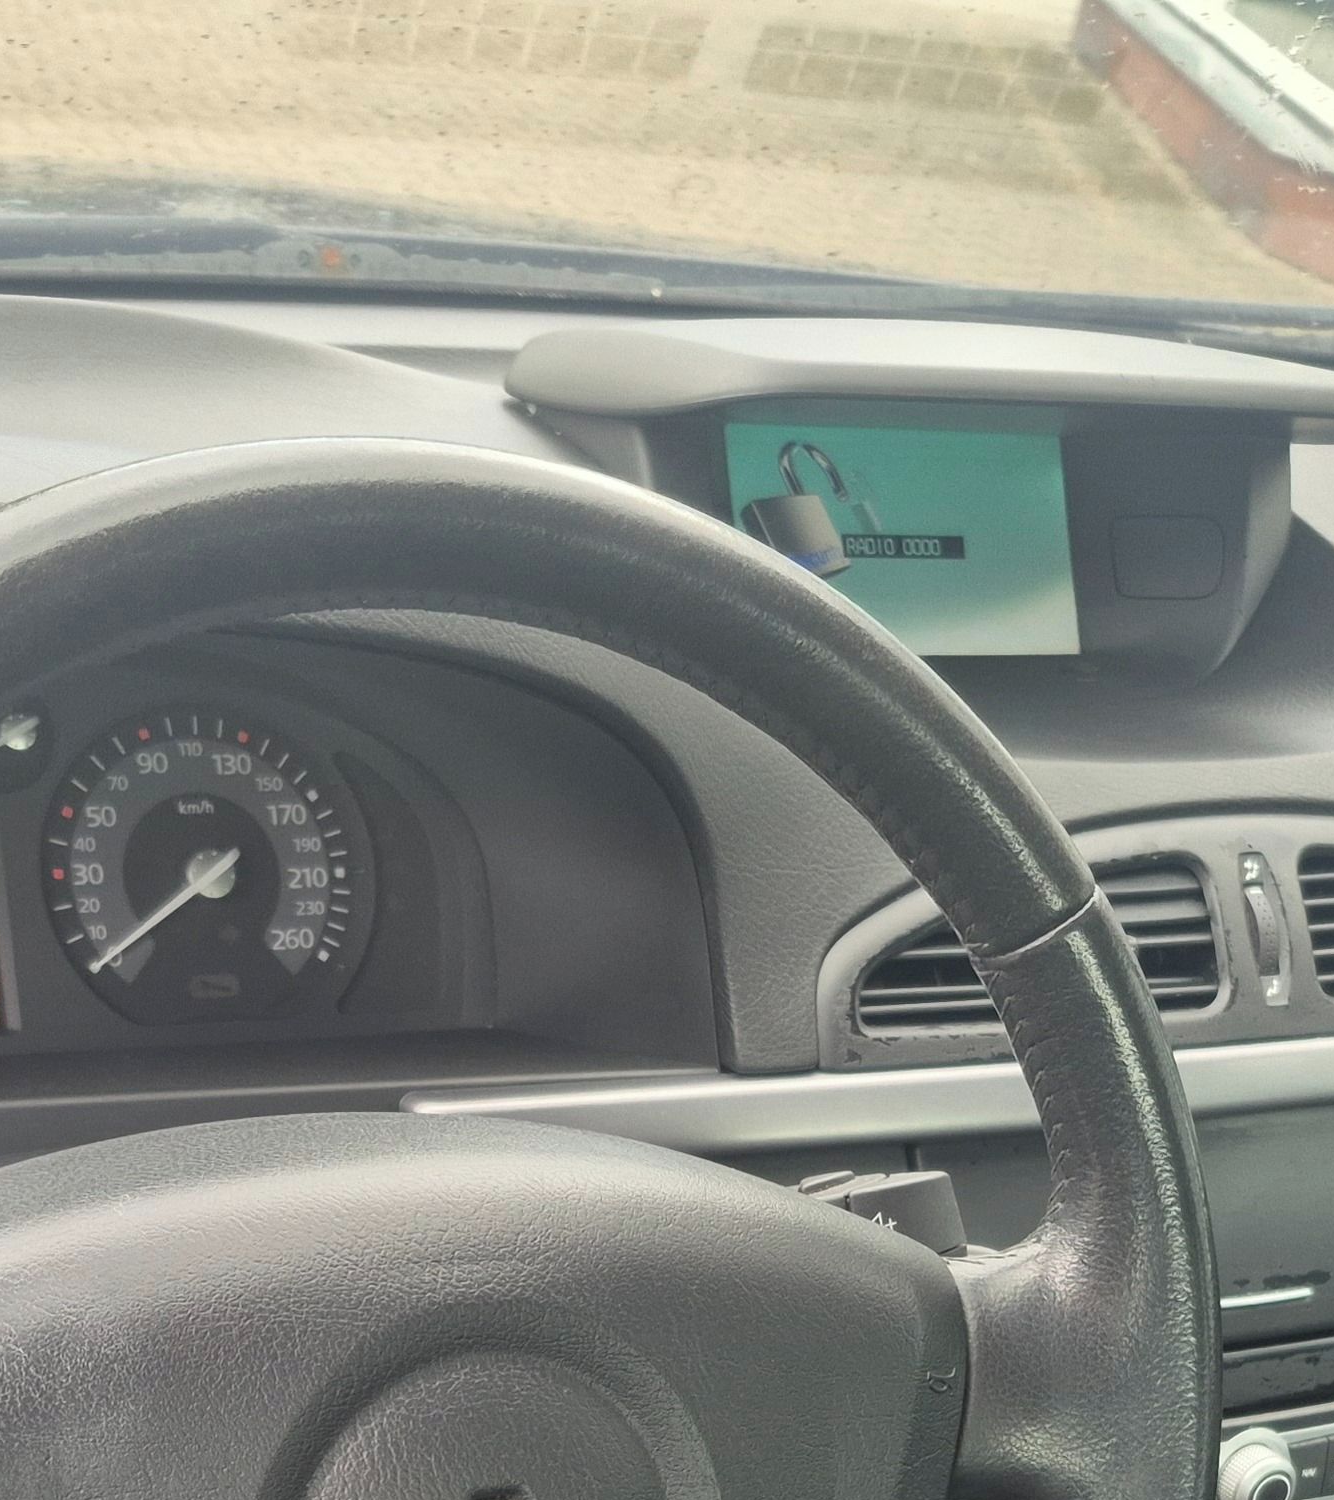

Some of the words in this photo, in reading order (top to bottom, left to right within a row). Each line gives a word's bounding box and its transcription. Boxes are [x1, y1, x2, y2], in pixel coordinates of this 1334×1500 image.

[846, 538, 895, 556] RADIO
[177, 741, 204, 757] 110
[136, 753, 168, 775] 90
[212, 754, 253, 776] 130
[107, 776, 129, 791] 70
[255, 777, 283, 792] 150
[178, 801, 215, 816] km/h
[267, 804, 307, 826] 170
[85, 807, 117, 828] 50
[74, 837, 97, 852] 40
[293, 837, 322, 852] 190
[72, 864, 105, 885] 30
[287, 868, 329, 889] 210
[79, 899, 101, 914] 20
[295, 901, 326, 916] 230
[88, 926, 108, 940] 10
[271, 929, 315, 950] 260
